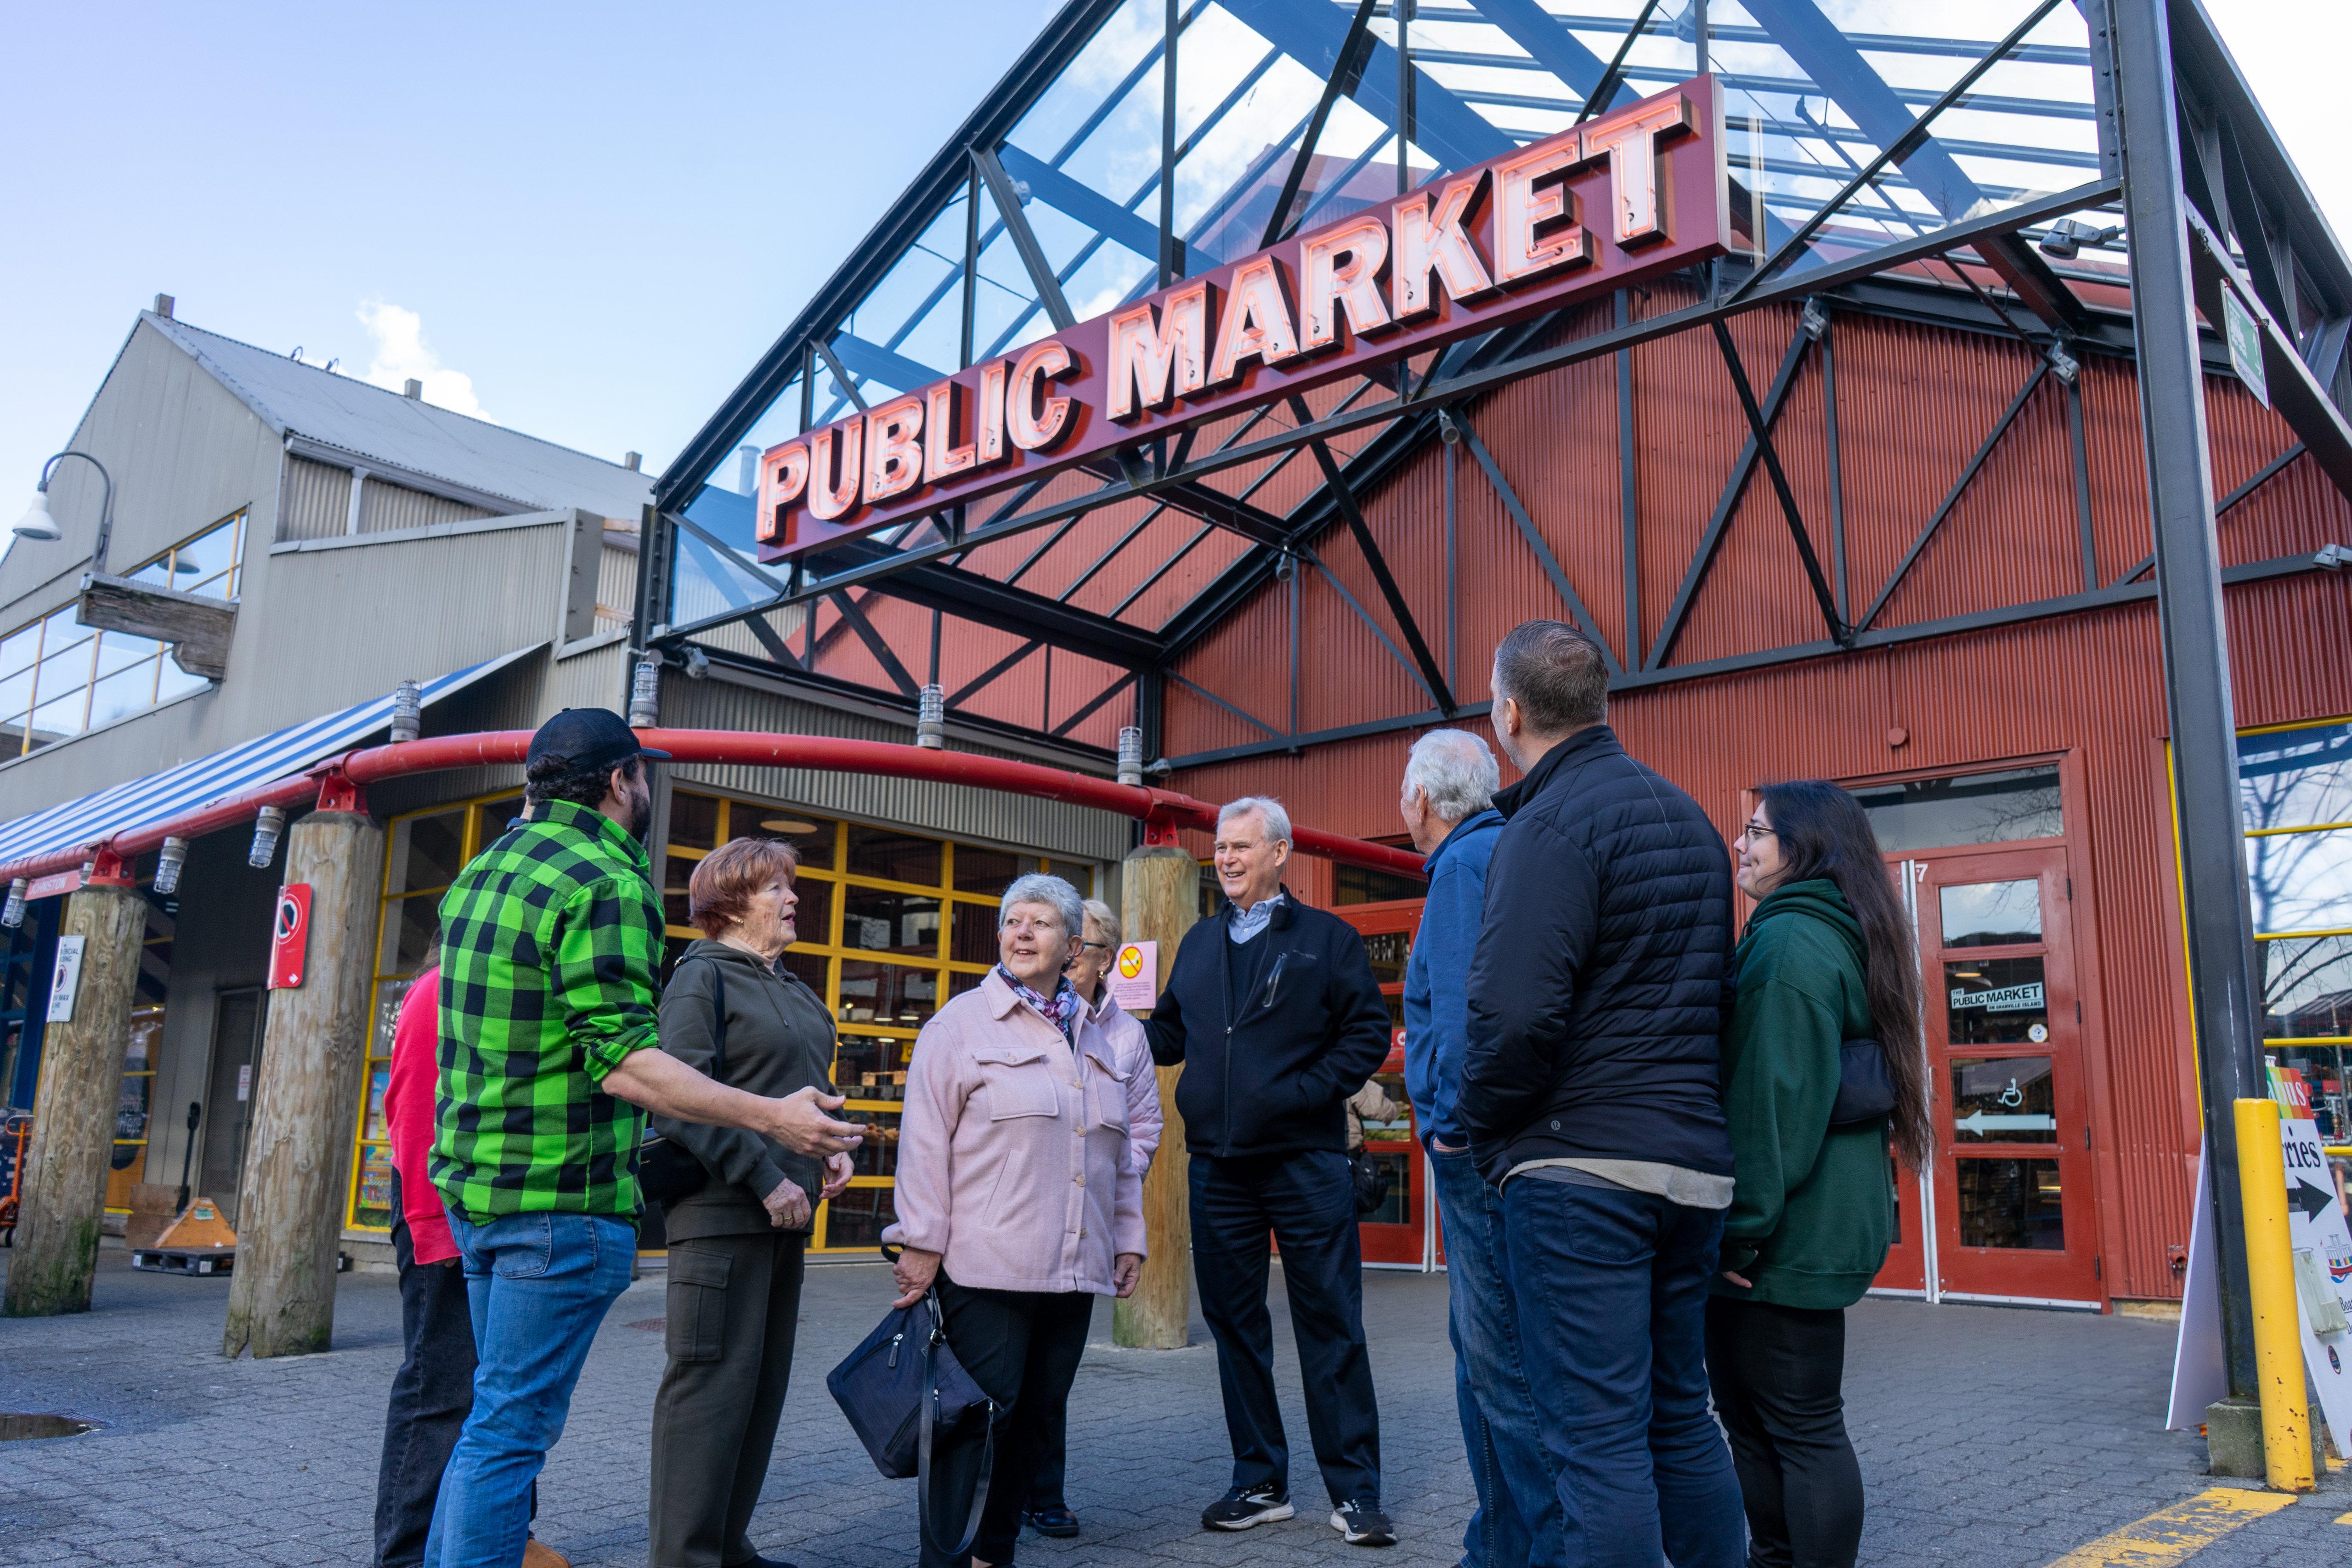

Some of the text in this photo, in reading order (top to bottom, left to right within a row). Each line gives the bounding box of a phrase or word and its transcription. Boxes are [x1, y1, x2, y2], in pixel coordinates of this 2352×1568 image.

[756, 91, 1688, 543] PUBLIC MARKET
[1915, 863, 1928, 883] 7
[29, 877, 67, 895] JOHNSTON
[1953, 985, 2040, 1006] PUBLIC MARKET
